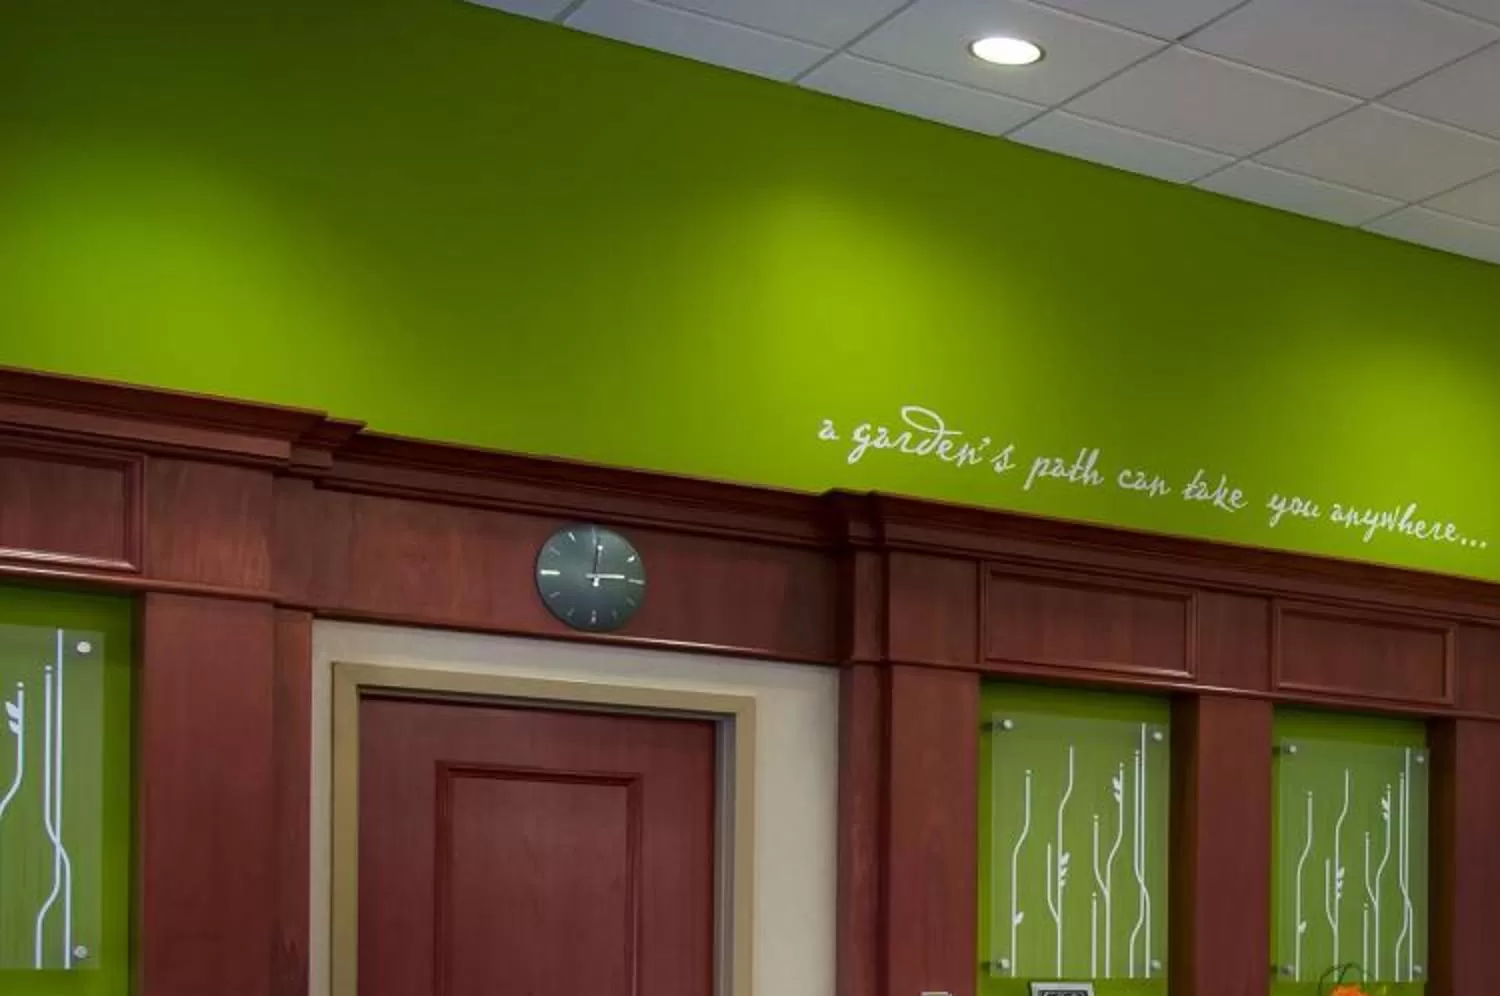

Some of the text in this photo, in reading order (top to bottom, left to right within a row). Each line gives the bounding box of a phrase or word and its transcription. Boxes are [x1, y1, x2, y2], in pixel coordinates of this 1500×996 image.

[818, 419, 839, 441] a
[847, 405, 1016, 474] garden's
[1022, 447, 1104, 491] path
[1116, 467, 1171, 497] can
[1181, 468, 1249, 513] take
[1265, 492, 1321, 528] you
